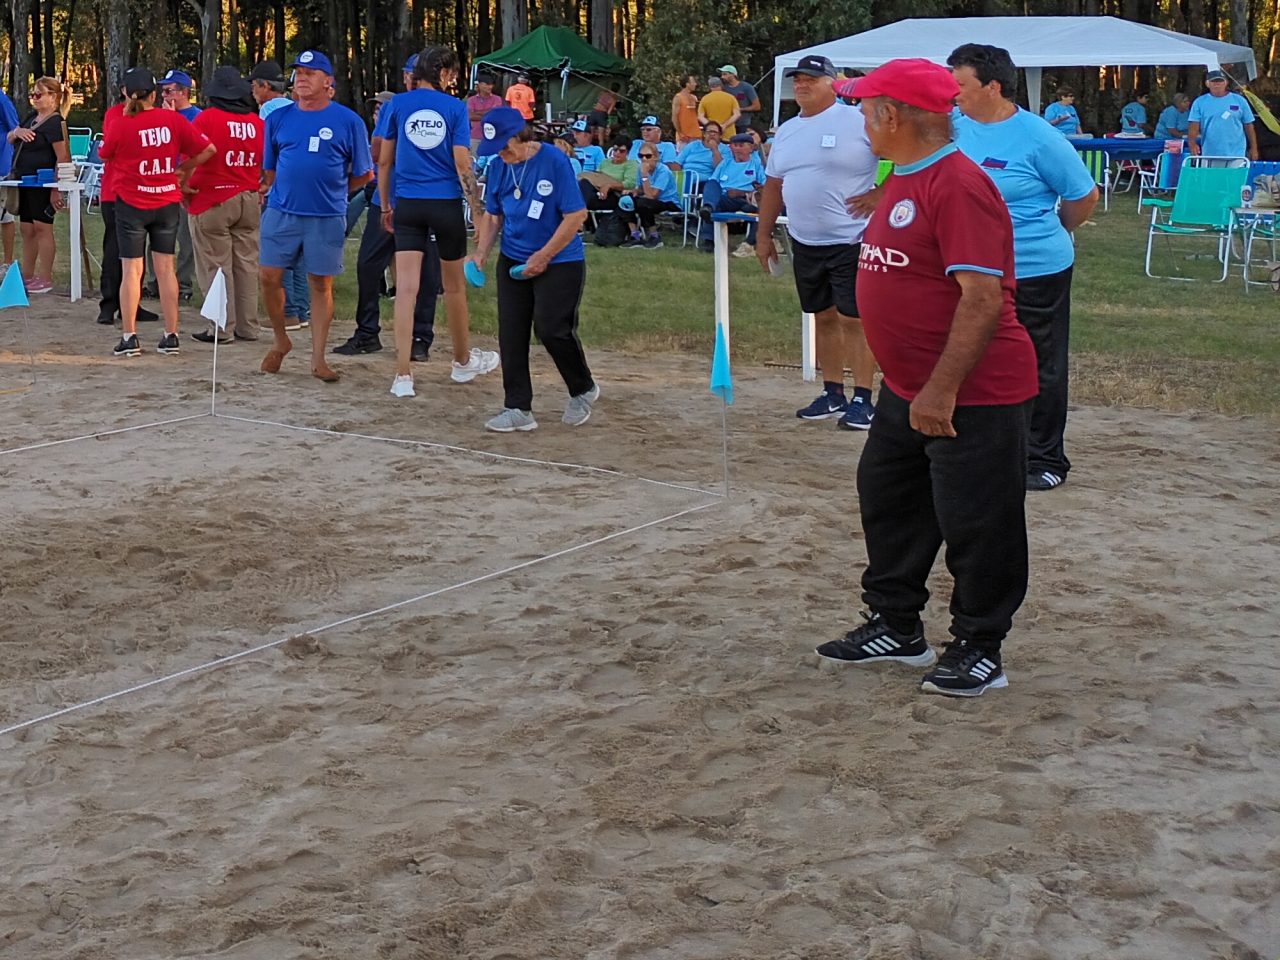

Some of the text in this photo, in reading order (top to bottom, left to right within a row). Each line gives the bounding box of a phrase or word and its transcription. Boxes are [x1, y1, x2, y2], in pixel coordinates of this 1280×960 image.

[227, 121, 256, 140] TEJO
[419, 120, 443, 128] TEJO
[139, 126, 171, 147] TEJO
[138, 157, 174, 175] C.A.I.
[859, 243, 910, 267] TIHAD
